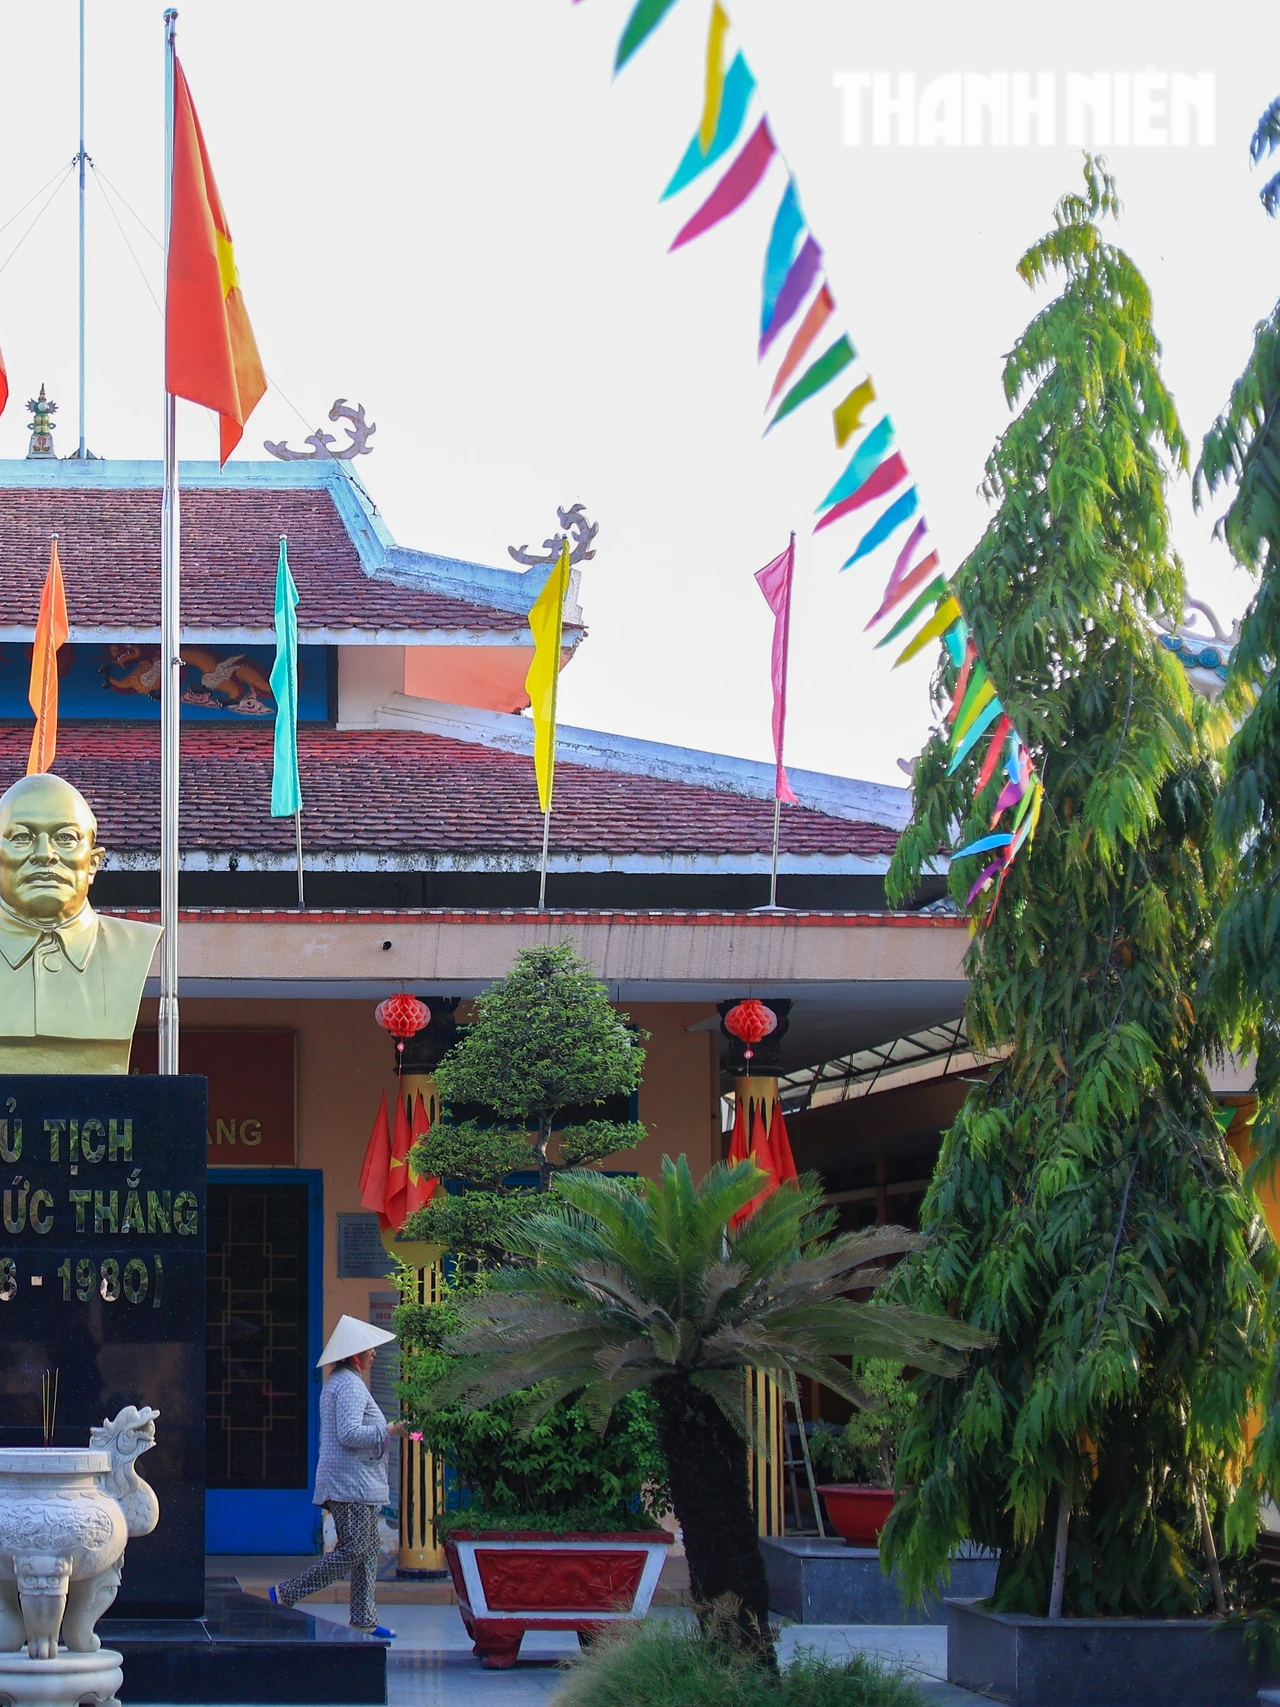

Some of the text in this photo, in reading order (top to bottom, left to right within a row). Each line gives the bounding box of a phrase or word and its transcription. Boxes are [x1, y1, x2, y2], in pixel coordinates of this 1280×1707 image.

[43, 1118, 133, 1176] TỊCH
[69, 1168, 198, 1236] THẮNG
[57, 1254, 164, 1308] 1980)
